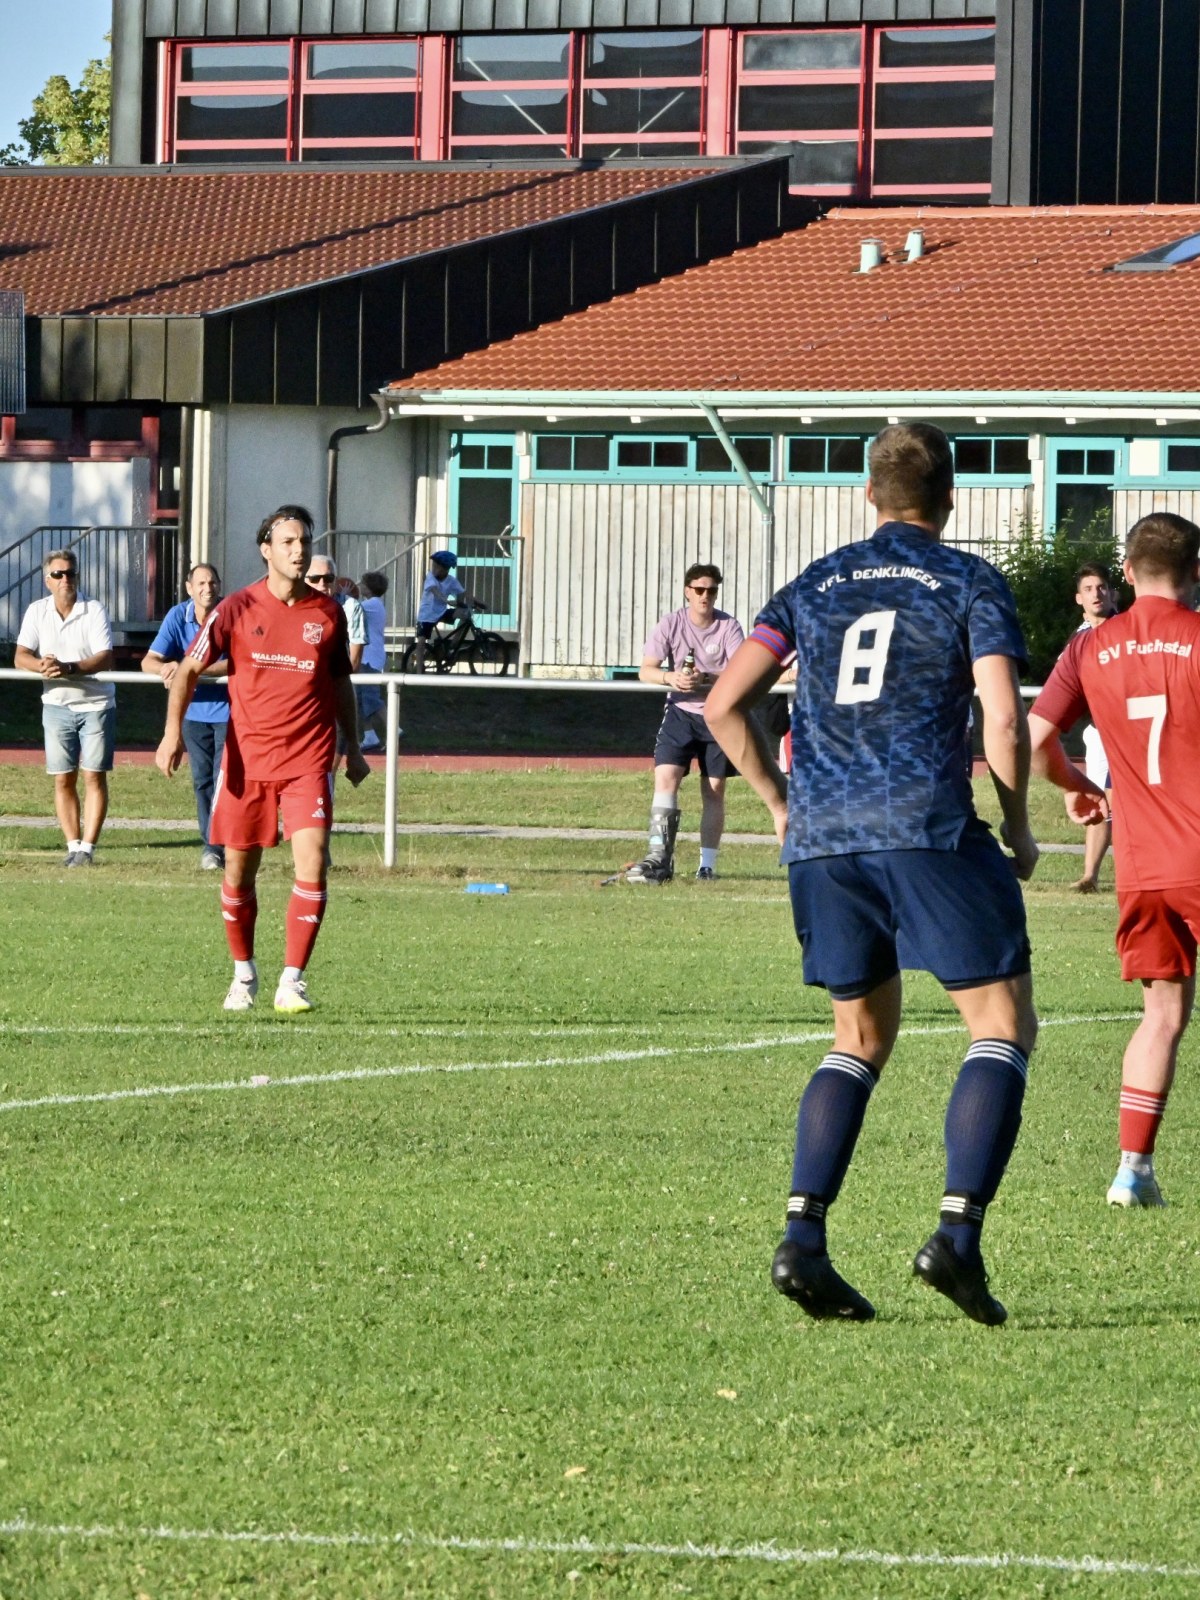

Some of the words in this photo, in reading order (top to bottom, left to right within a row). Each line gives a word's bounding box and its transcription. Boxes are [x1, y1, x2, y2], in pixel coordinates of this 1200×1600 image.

[852, 566, 941, 591] DENKLINGEN
[251, 652, 297, 664] WALDHÖR
[835, 610, 897, 705] 8
[1098, 643, 1121, 665] SV
[1126, 639, 1192, 658] Fuchstal
[1126, 694, 1168, 784] 7
